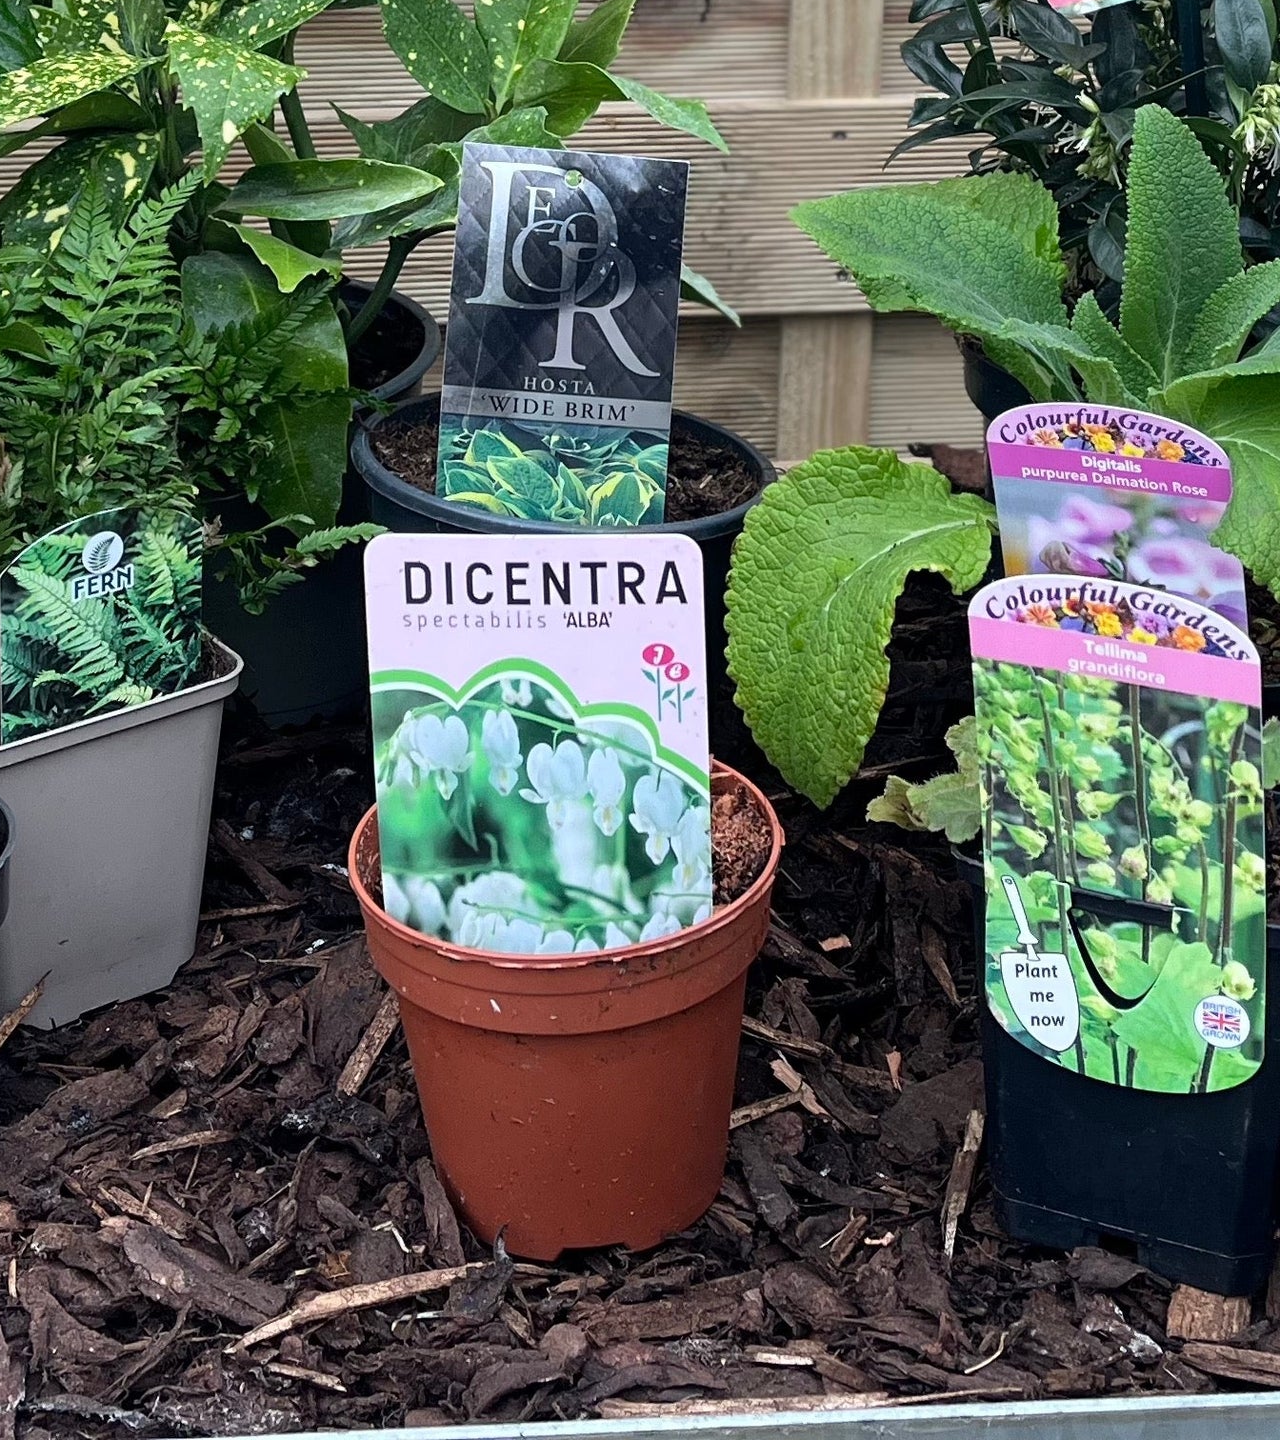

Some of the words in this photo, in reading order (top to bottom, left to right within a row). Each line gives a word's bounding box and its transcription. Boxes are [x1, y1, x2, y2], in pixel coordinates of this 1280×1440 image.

[523, 376, 596, 395] HOSTA
[1000, 408, 1110, 443] Colourful
[1118, 412, 1223, 466] Gardens
[1081, 456, 1142, 474] Digitalis
[1022, 465, 1088, 483] purpurea
[1092, 471, 1169, 492] Dalmation
[1172, 481, 1208, 497] Rose
[74, 567, 133, 599] FERN
[404, 560, 689, 605] DICENTRA
[402, 610, 547, 632] spectabilis
[985, 582, 1120, 619] Colourful
[1130, 591, 1250, 661] Gardens
[1083, 640, 1148, 664] Tellima
[1066, 658, 1165, 685] grandiflora
[1015, 963, 1058, 978] Plant
[1030, 991, 1054, 1002] me
[1202, 1001, 1241, 1015] BRITISH
[1030, 1014, 1065, 1027] now
[1202, 1028, 1240, 1042] GROWN
